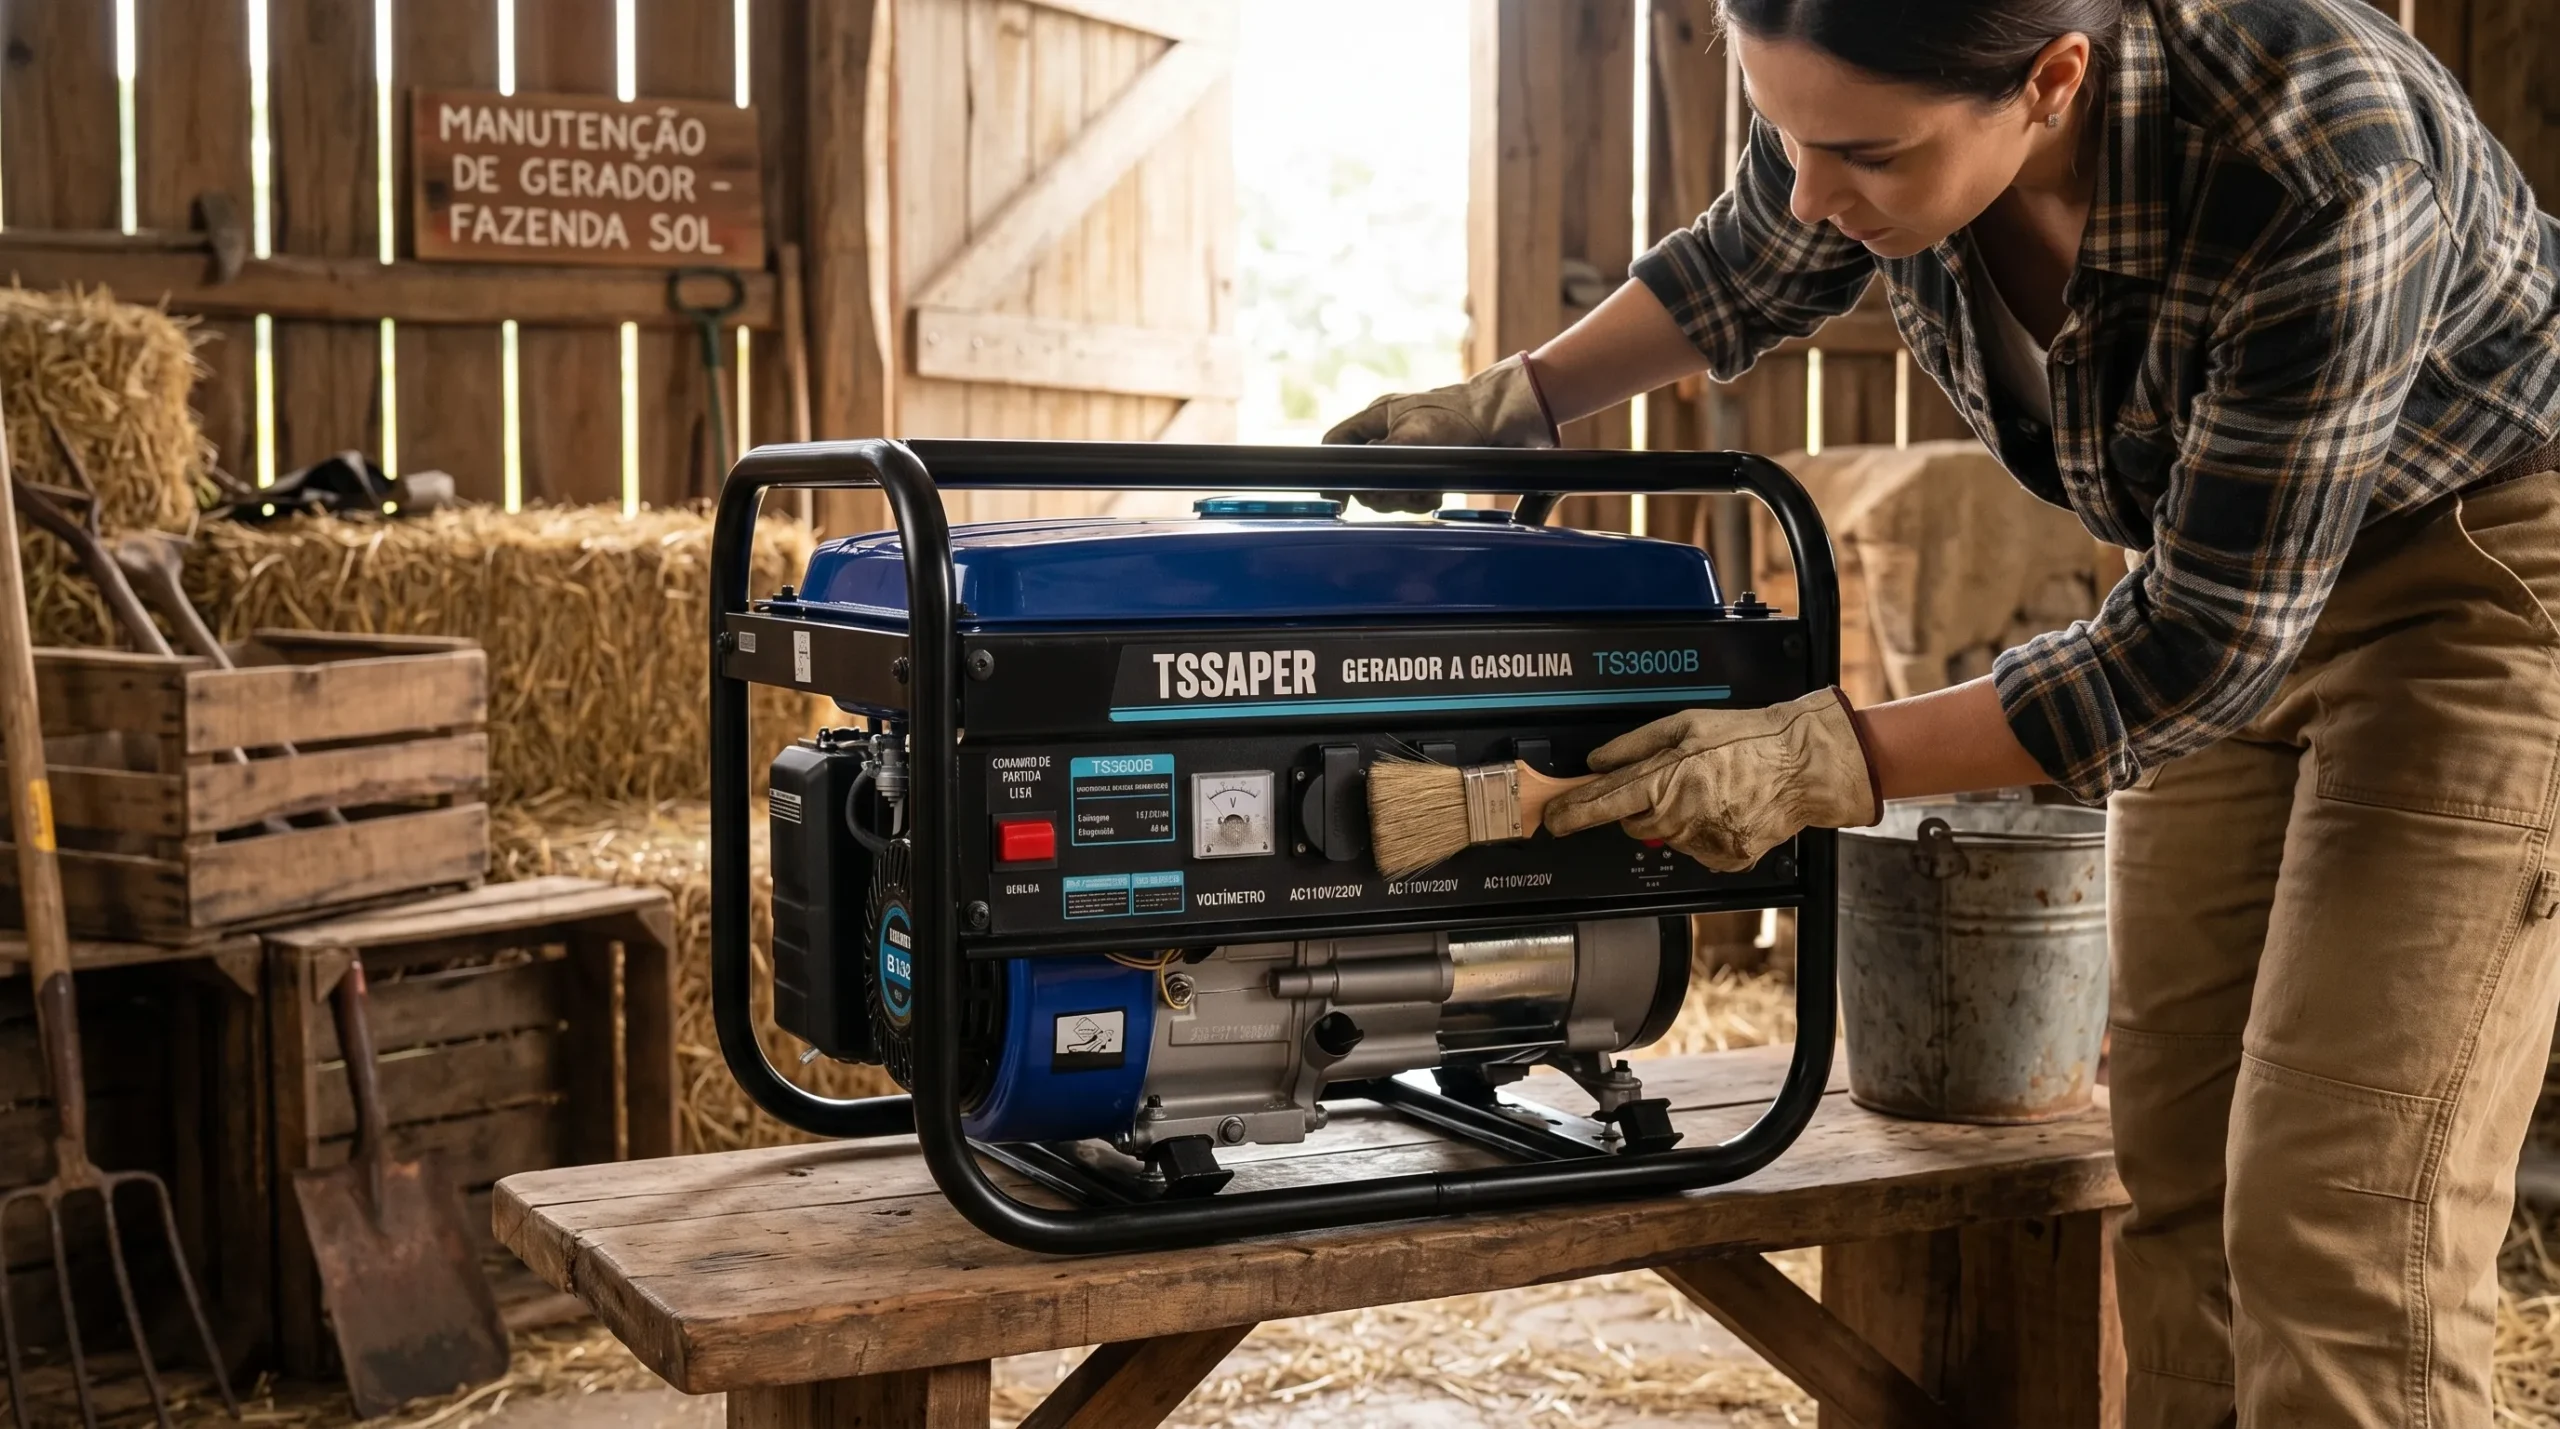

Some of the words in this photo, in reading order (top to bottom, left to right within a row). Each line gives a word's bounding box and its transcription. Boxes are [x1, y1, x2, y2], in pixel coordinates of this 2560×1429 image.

[440, 103, 706, 161] MANUTENÇÃO
[452, 154, 500, 193] DE
[520, 157, 696, 203] GERADOR
[450, 203, 630, 249] FAZENDA
[649, 213, 723, 254] SOL
[1153, 650, 1316, 699] TSSAPER
[1342, 656, 1443, 683] GERADOR
[1450, 655, 1464, 680] A
[1471, 653, 1573, 679] GASOLINA
[1592, 649, 1700, 675] TS3600B
[1038, 755, 1051, 767] DE
[1002, 770, 1041, 782] PARTIDA
[1484, 873, 1552, 890] AC110V/220V
[1196, 887, 1266, 906] VOLTÍMETRO
[1290, 884, 1363, 901] AC110V/220V
